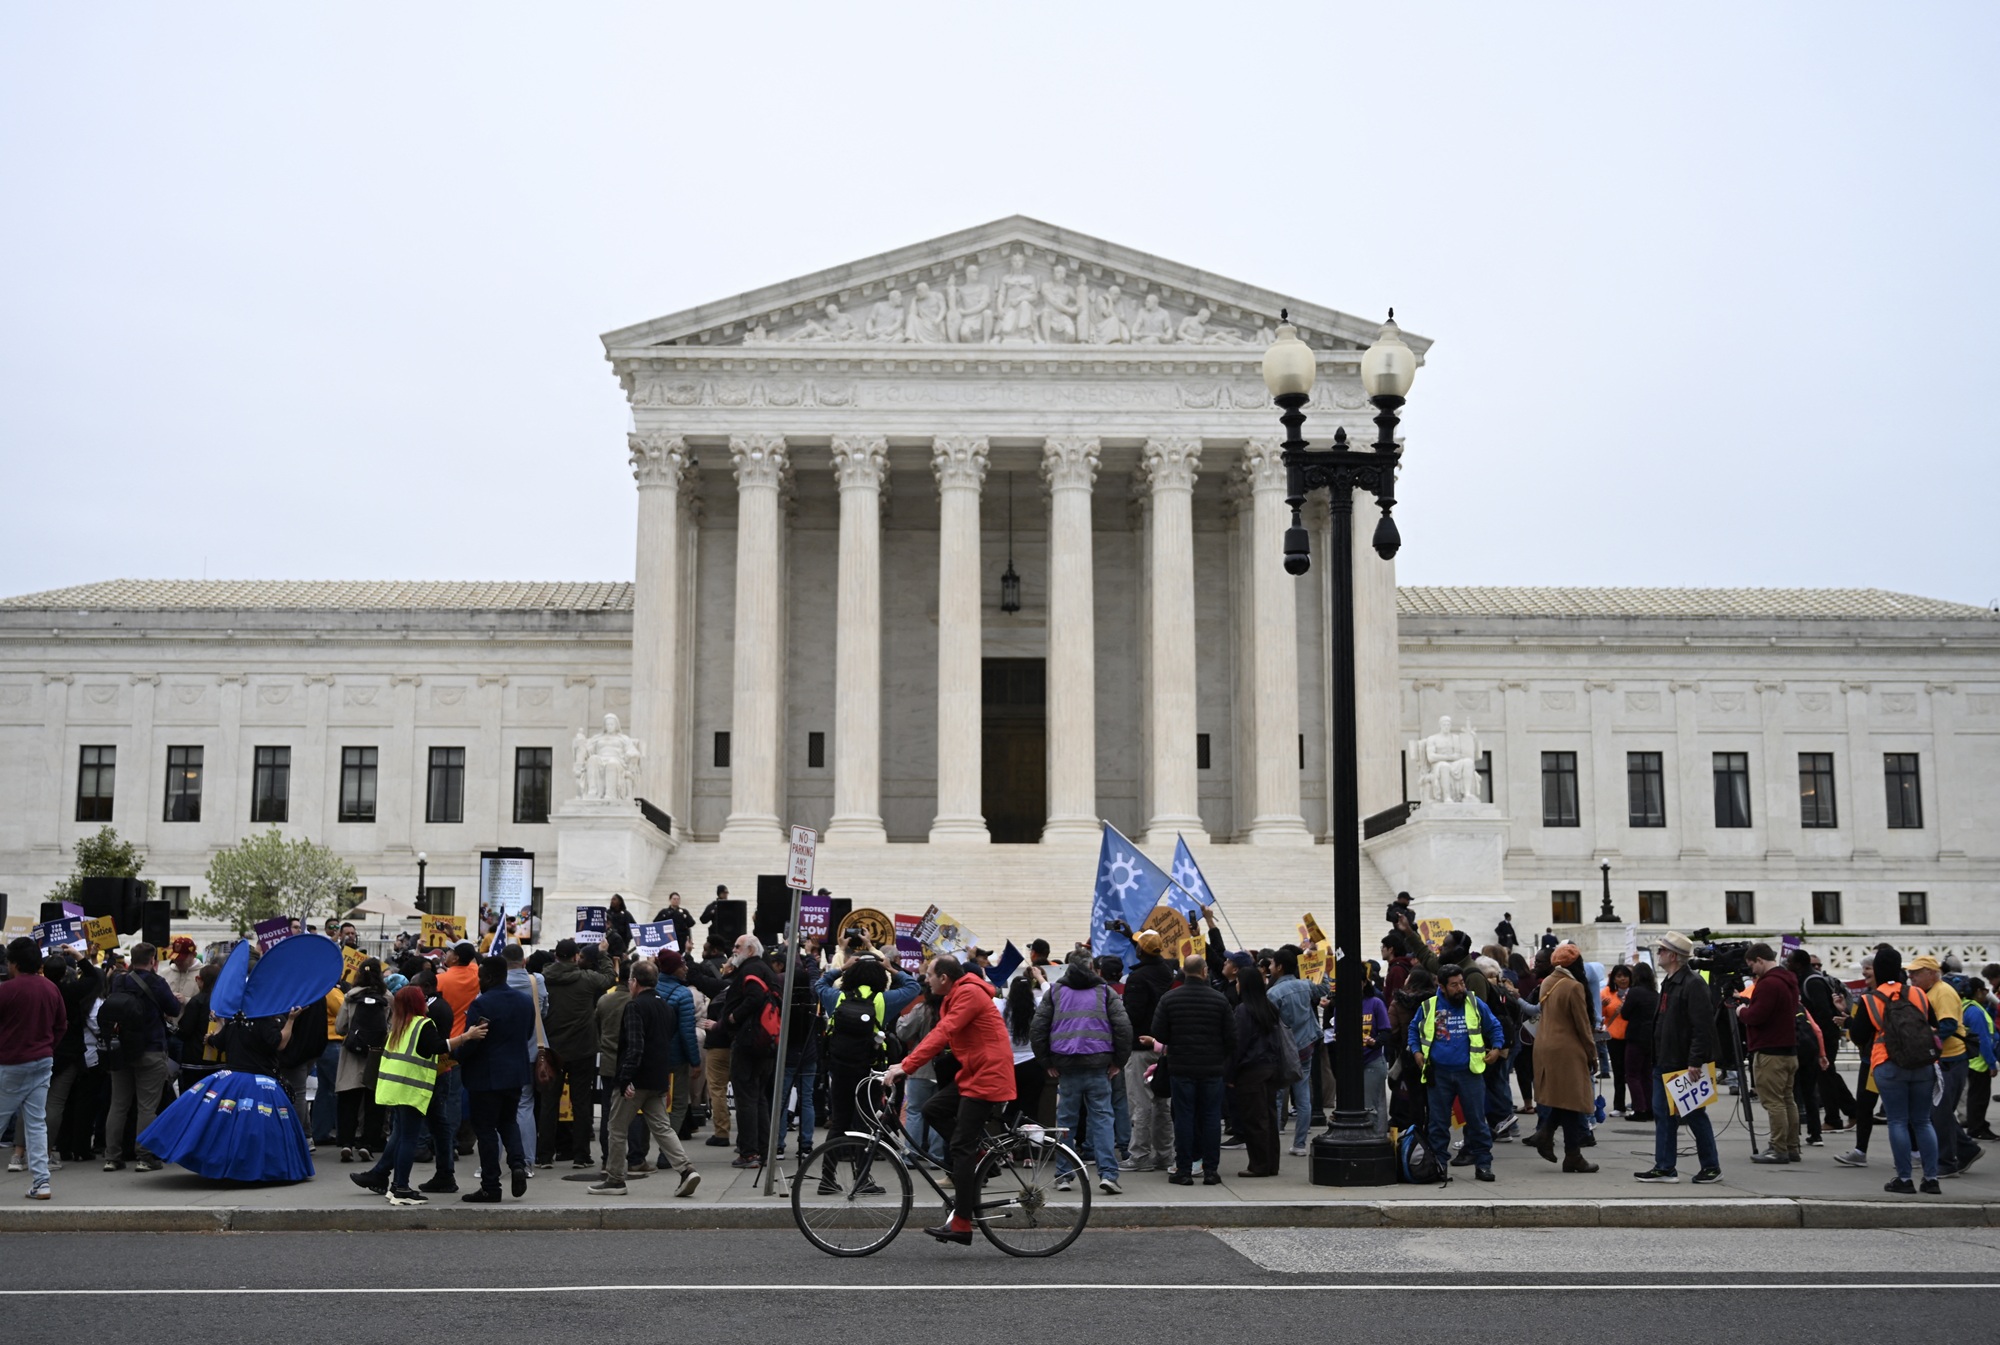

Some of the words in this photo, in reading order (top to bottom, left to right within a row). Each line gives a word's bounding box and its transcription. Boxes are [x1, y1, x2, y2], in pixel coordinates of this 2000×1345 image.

[873, 385, 943, 402] EQUAL
[950, 385, 1032, 403] JUSTICE
[1042, 386, 1111, 403] UNDER
[1120, 386, 1159, 403] LAW
[799, 831, 809, 844] NO
[792, 843, 814, 858] PARKING
[796, 857, 808, 867] ANY
[794, 866, 807, 877] TIME
[88, 920, 100, 929] TPS
[803, 914, 825, 923] TPS
[90, 928, 113, 939] Justice
[258, 926, 290, 941] PROTECT
[901, 959, 920, 969] TPS
[1675, 1075, 1706, 1094] SA
[1678, 1081, 1710, 1112] TPS
